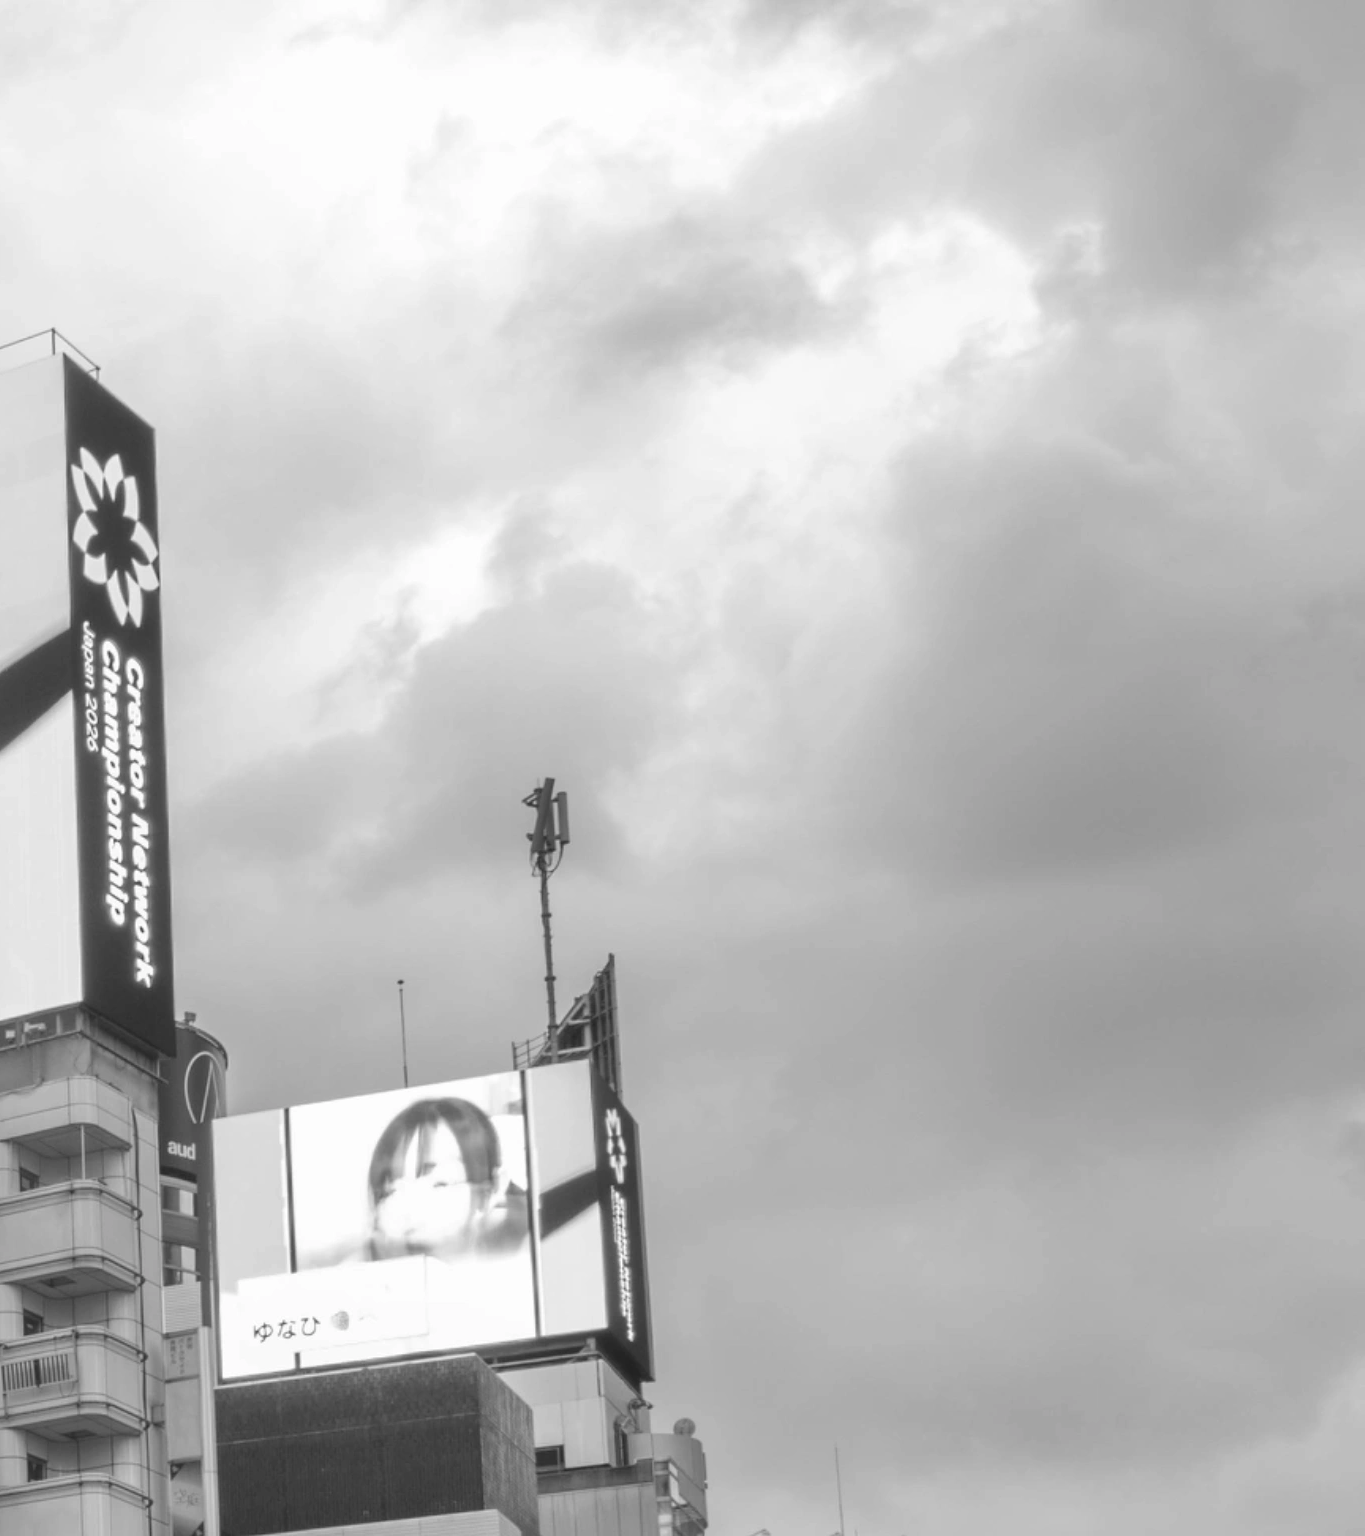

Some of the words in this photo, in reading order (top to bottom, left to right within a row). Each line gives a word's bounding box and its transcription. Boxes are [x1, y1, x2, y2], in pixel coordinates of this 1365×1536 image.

[82, 621, 97, 690] Japan
[85, 693, 99, 752] 2026
[101, 639, 128, 926] Championship
[126, 656, 145, 809] Creator
[131, 813, 154, 988] Network
